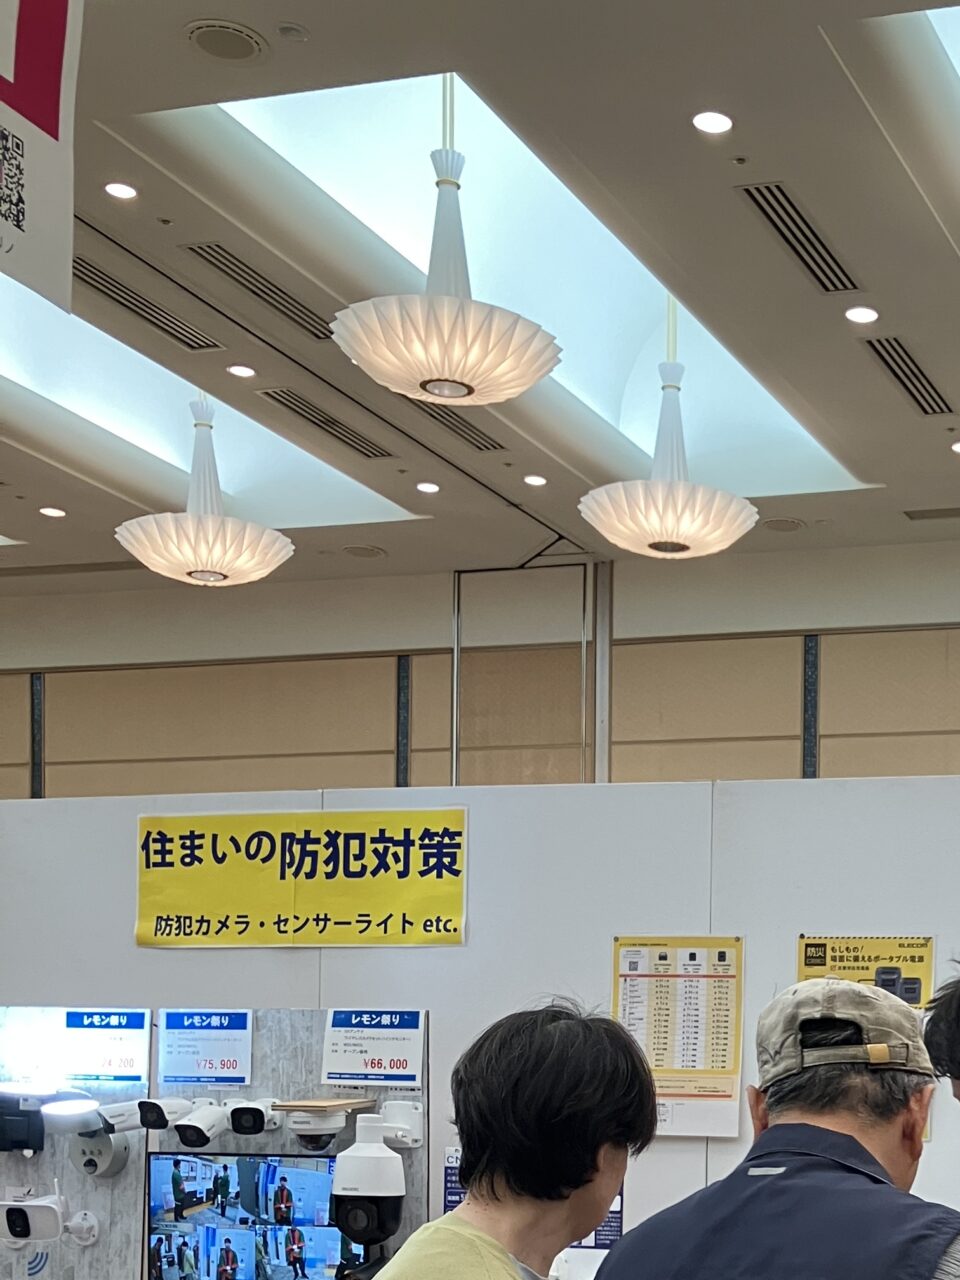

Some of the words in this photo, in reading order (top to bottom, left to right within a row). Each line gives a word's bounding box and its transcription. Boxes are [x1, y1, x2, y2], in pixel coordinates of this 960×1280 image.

[140, 826, 464, 881] 住まいの防犯対策
[153, 911, 415, 938] 防犯カメラ・センサーライト
[422, 914, 459, 935] etc.
[183, 1015, 229, 1027] レモン祭り
[351, 1013, 400, 1025] レモン祭り
[196, 1059, 238, 1071] ¥75,900
[363, 1058, 408, 1070] ¥66,000
